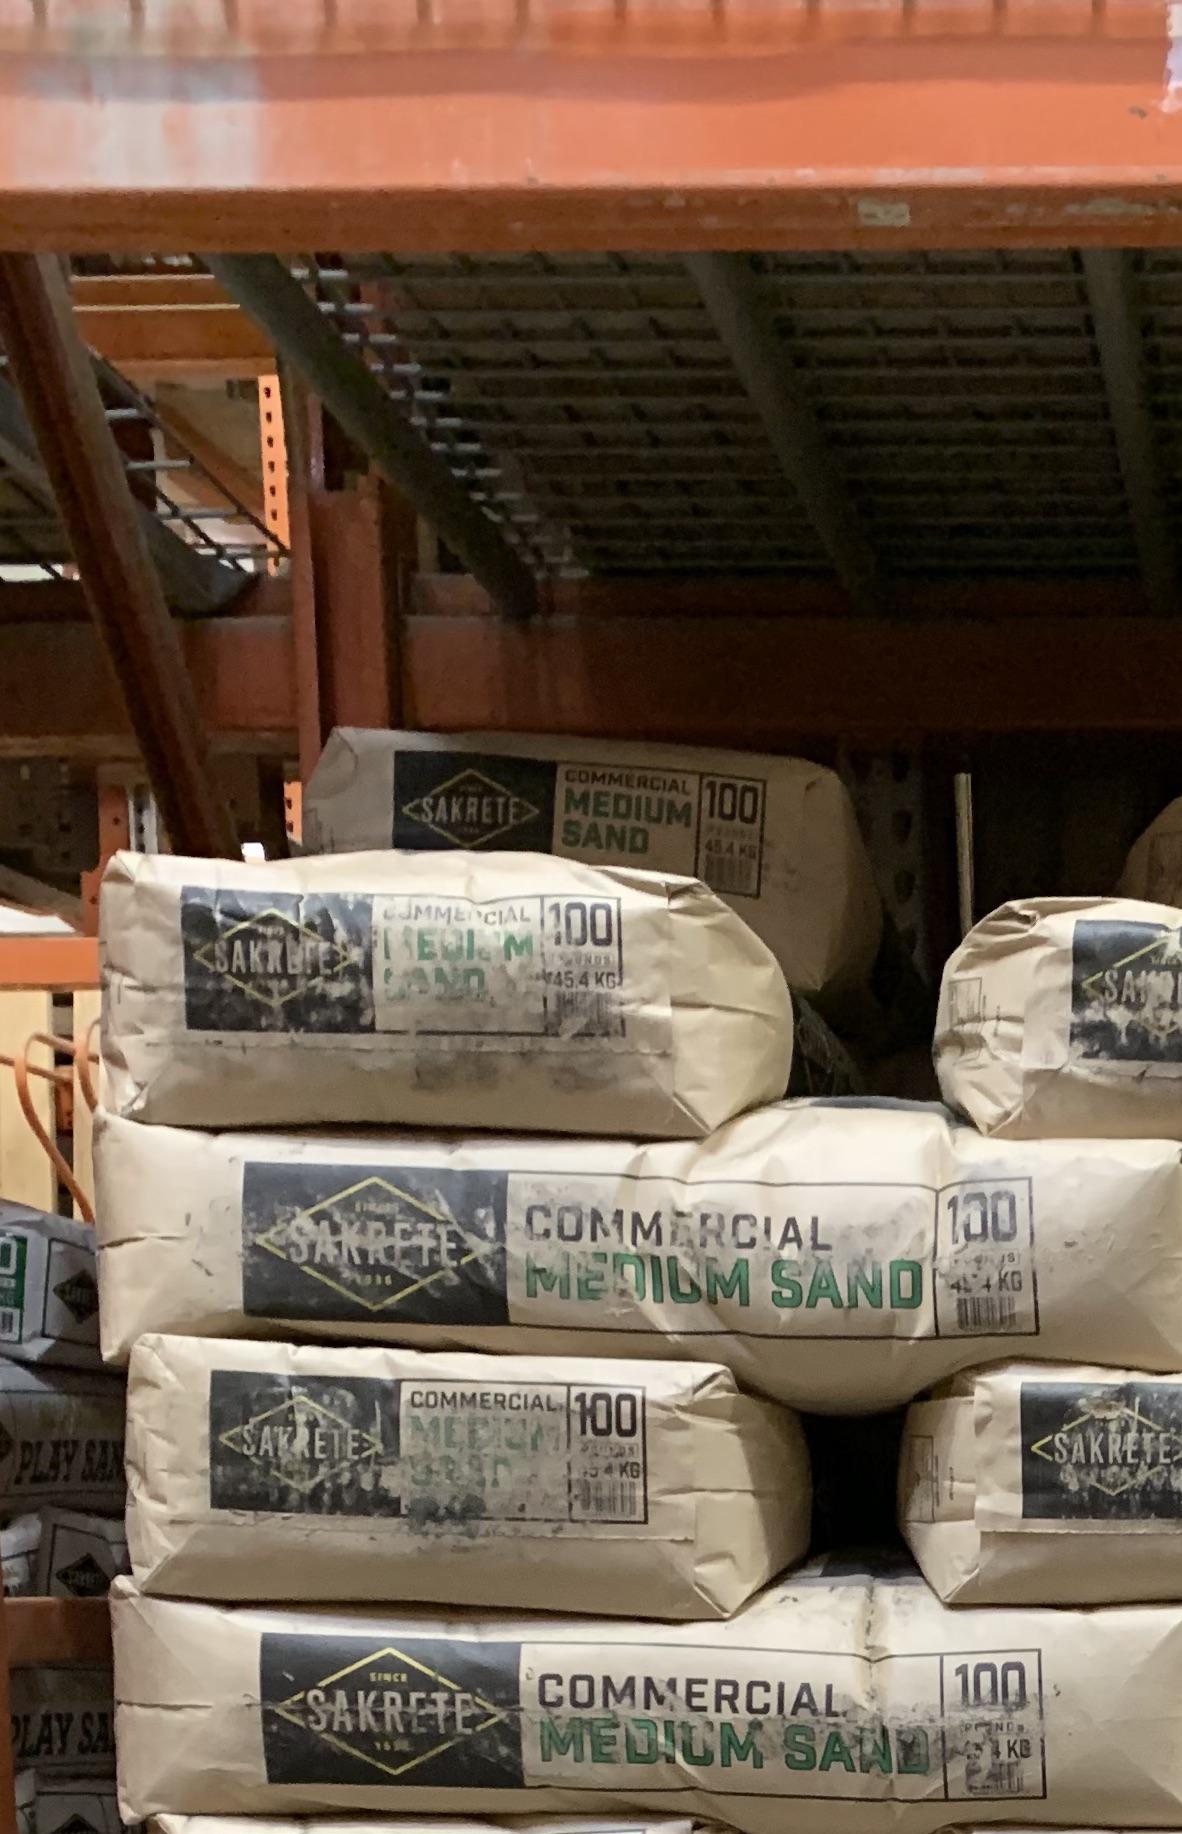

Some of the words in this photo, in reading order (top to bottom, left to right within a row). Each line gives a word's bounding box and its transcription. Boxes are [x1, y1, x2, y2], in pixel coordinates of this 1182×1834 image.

[565, 769, 690, 795] COMMERCIAL
[705, 780, 759, 824] 100
[422, 797, 519, 824] SAKRETE
[564, 788, 692, 828] MEDIUM
[561, 820, 650, 855] SAND
[547, 902, 612, 947] 100
[594, 972, 617, 989] KG
[526, 1202, 834, 1253] COMMERCIAL
[947, 1191, 1017, 1245] 100
[526, 1253, 751, 1309] MEDIUM
[771, 1255, 924, 1311] SAND
[999, 1270, 1022, 1292] KG
[410, 1391, 557, 1413] COMMERCIAL
[574, 1392, 638, 1437] 100
[15, 1440, 77, 1484] PLAY
[618, 1462, 640, 1479] KG
[1053, 1431, 1173, 1466] SAKRETE
[538, 1672, 841, 1718] COMMERCIAL
[953, 1661, 1027, 1711] 100
[306, 1689, 473, 1735] SAKRETE
[540, 1716, 765, 1770] MEDIUM
[784, 1722, 930, 1775] SAND
[1007, 1738, 1032, 1758] KG
